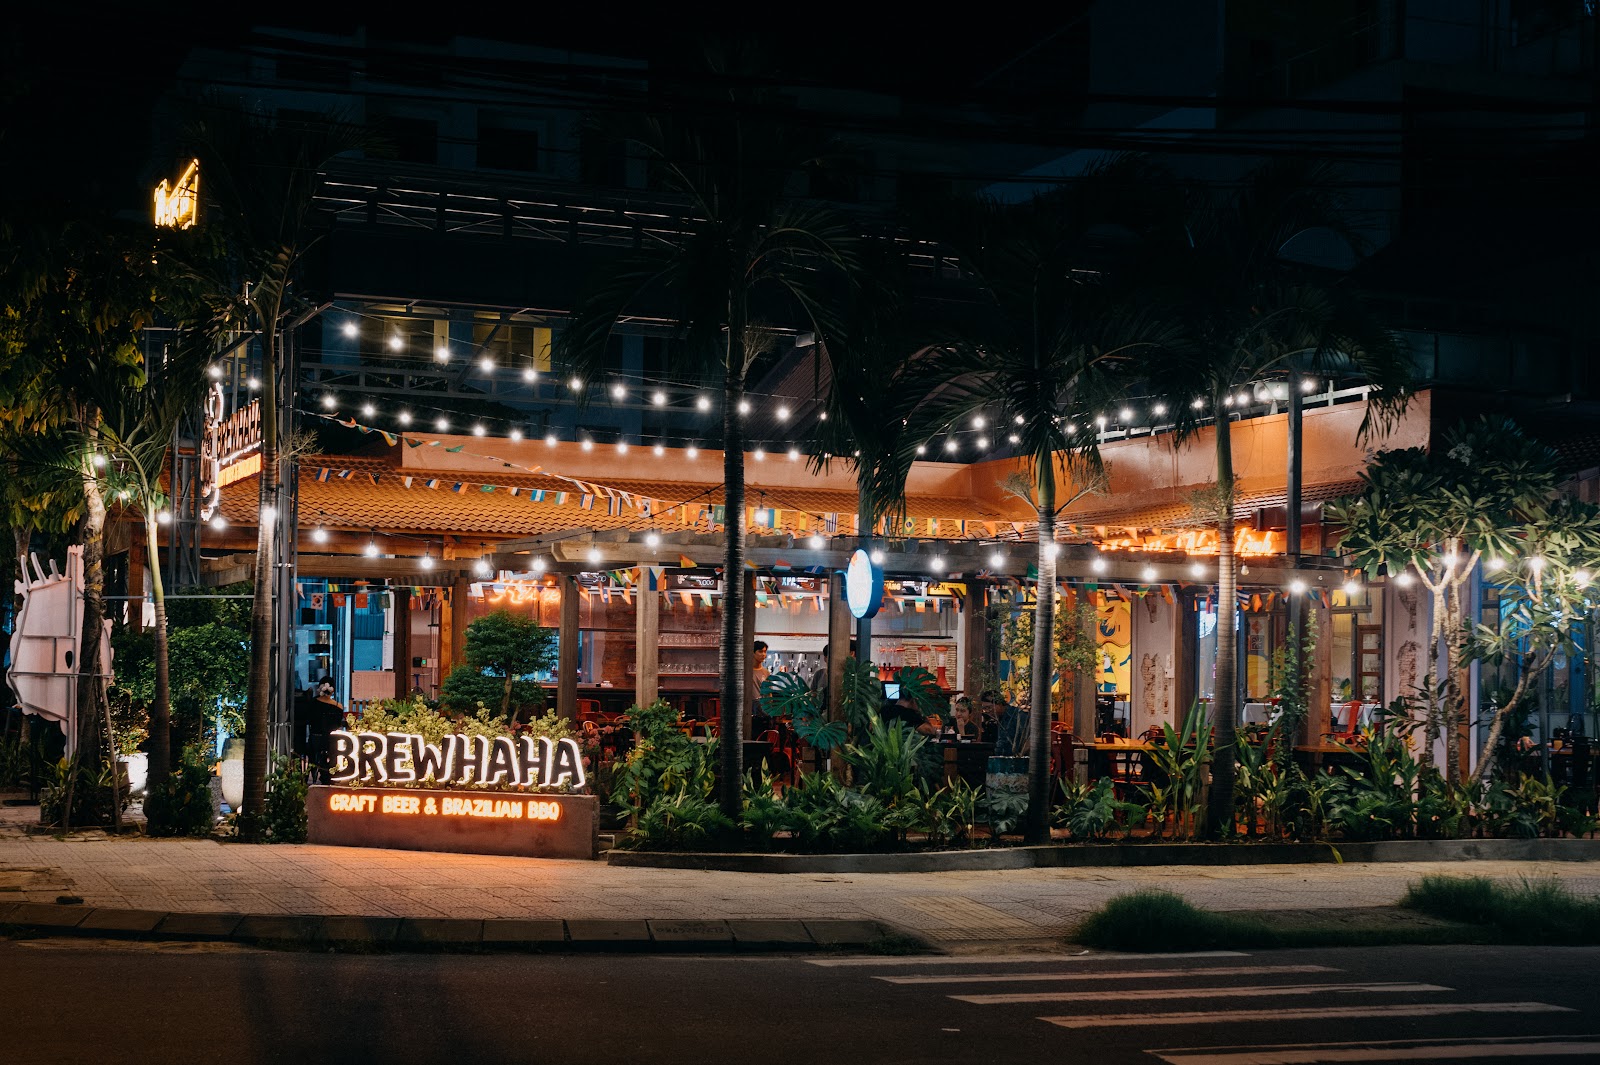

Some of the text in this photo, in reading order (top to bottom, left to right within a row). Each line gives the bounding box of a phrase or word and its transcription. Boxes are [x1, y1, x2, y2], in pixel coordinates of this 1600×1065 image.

[329, 729, 586, 789] BREWHAHA
[329, 794, 560, 821] CRAFT BEER & BRAZILIAN BBQ
